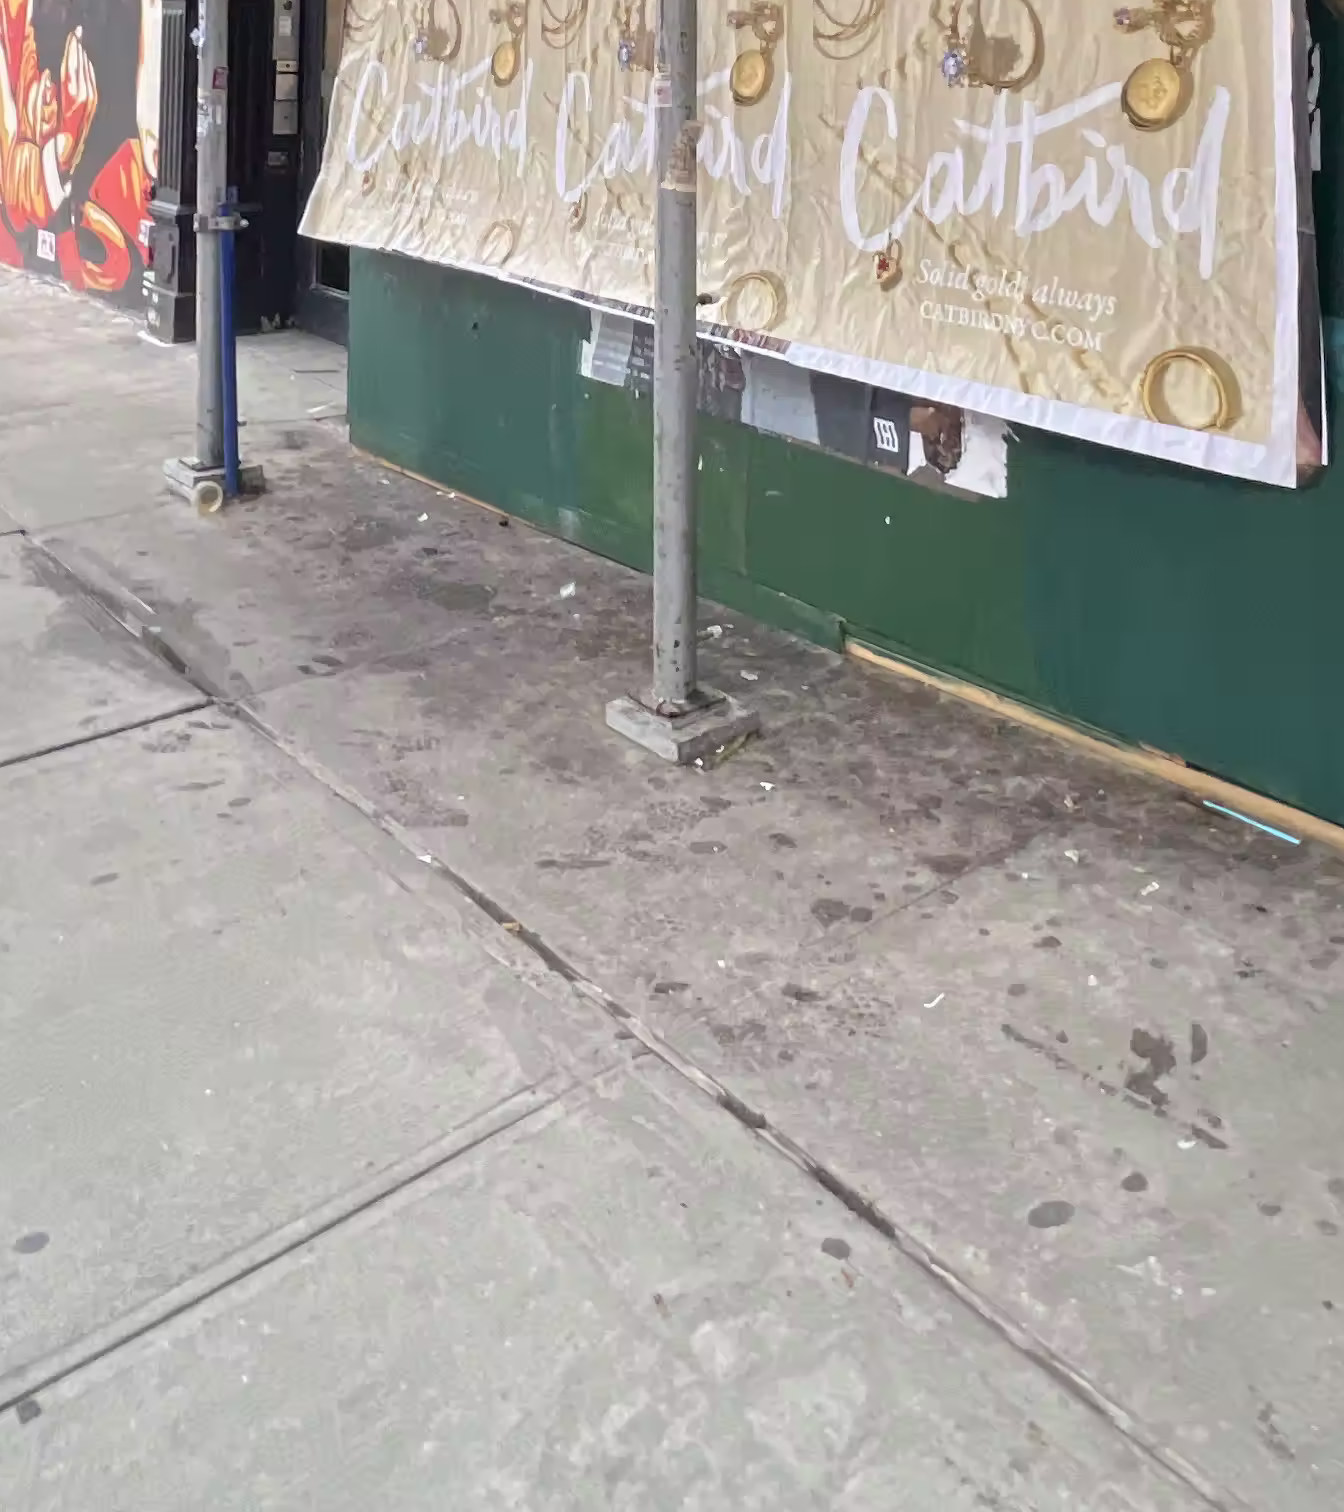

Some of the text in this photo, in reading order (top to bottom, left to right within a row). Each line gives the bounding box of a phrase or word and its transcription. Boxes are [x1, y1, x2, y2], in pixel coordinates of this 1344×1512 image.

[346, 57, 533, 178] Catbird
[556, 71, 792, 219] Catird
[840, 80, 1230, 280] Catbird
[917, 257, 971, 291] Solid
[1032, 275, 1119, 323] always
